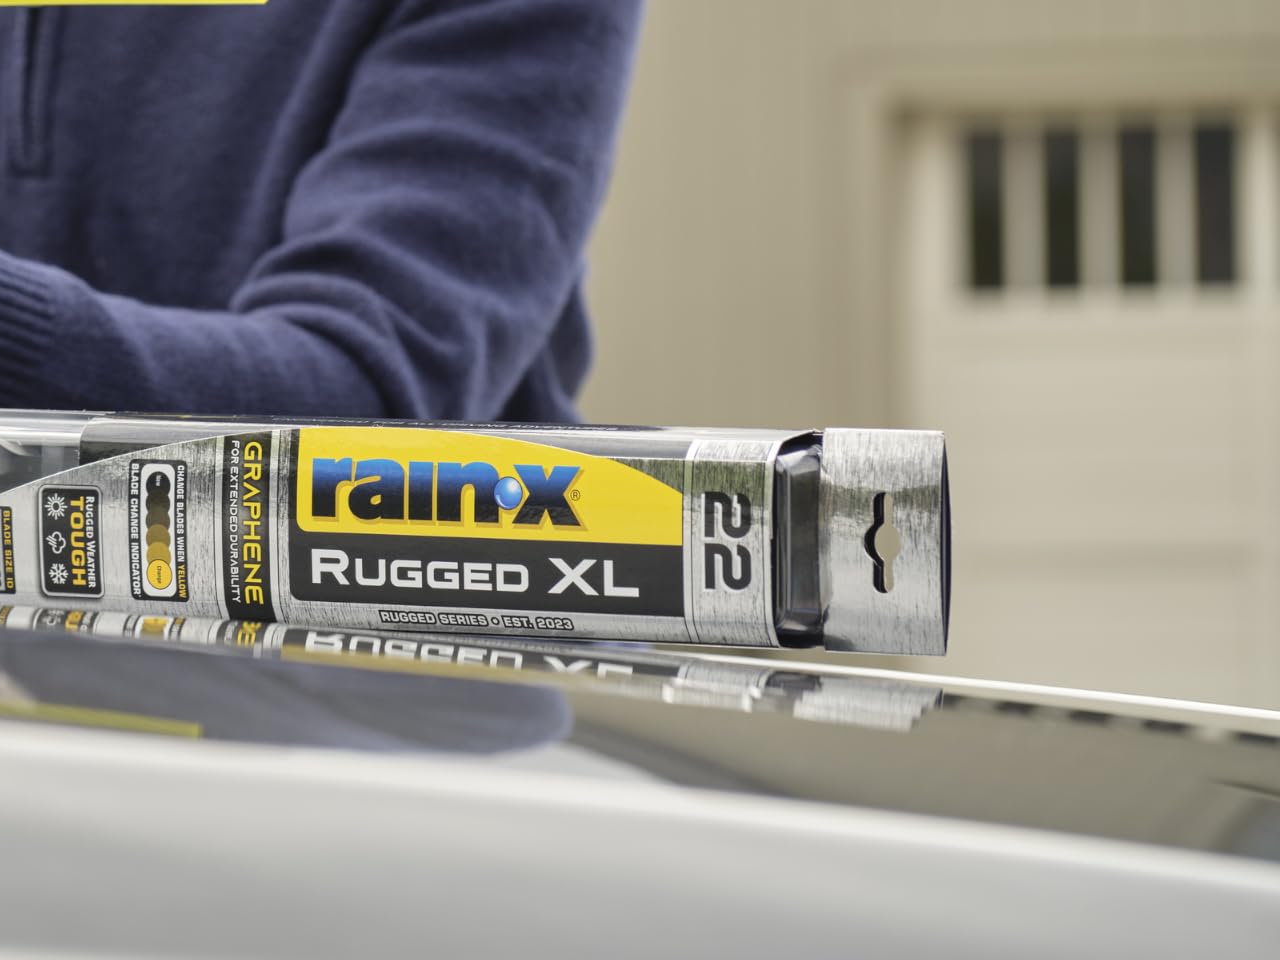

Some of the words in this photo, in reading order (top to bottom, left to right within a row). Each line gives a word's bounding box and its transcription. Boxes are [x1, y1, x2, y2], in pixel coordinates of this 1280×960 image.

[230, 440, 240, 464] FOR
[130, 463, 140, 495] BLADE
[176, 465, 185, 500] CHANGE
[229, 466, 239, 532] EXTENDED
[3, 510, 11, 545] BLADE
[85, 496, 95, 539] RUGGED
[130, 498, 139, 539] CHANGE
[176, 502, 185, 534] BLADES
[242, 441, 264, 605] GRAPHENE
[70, 495, 87, 586] TOUGH
[176, 536, 185, 562] WHEN
[703, 491, 752, 591] 22
[4, 549, 13, 573] SIZE
[86, 540, 97, 588] WEATHER
[229, 534, 241, 603] DURABILITY
[311, 547, 529, 593] RUGGED
[547, 557, 640, 599] XL
[6, 577, 14, 589] ID
[177, 564, 187, 599] YELLOW
[380, 610, 435, 624] RUGGED
[439, 613, 488, 626] SERIES
[503, 616, 532, 628] EST.
[537, 617, 573, 630] 2023
